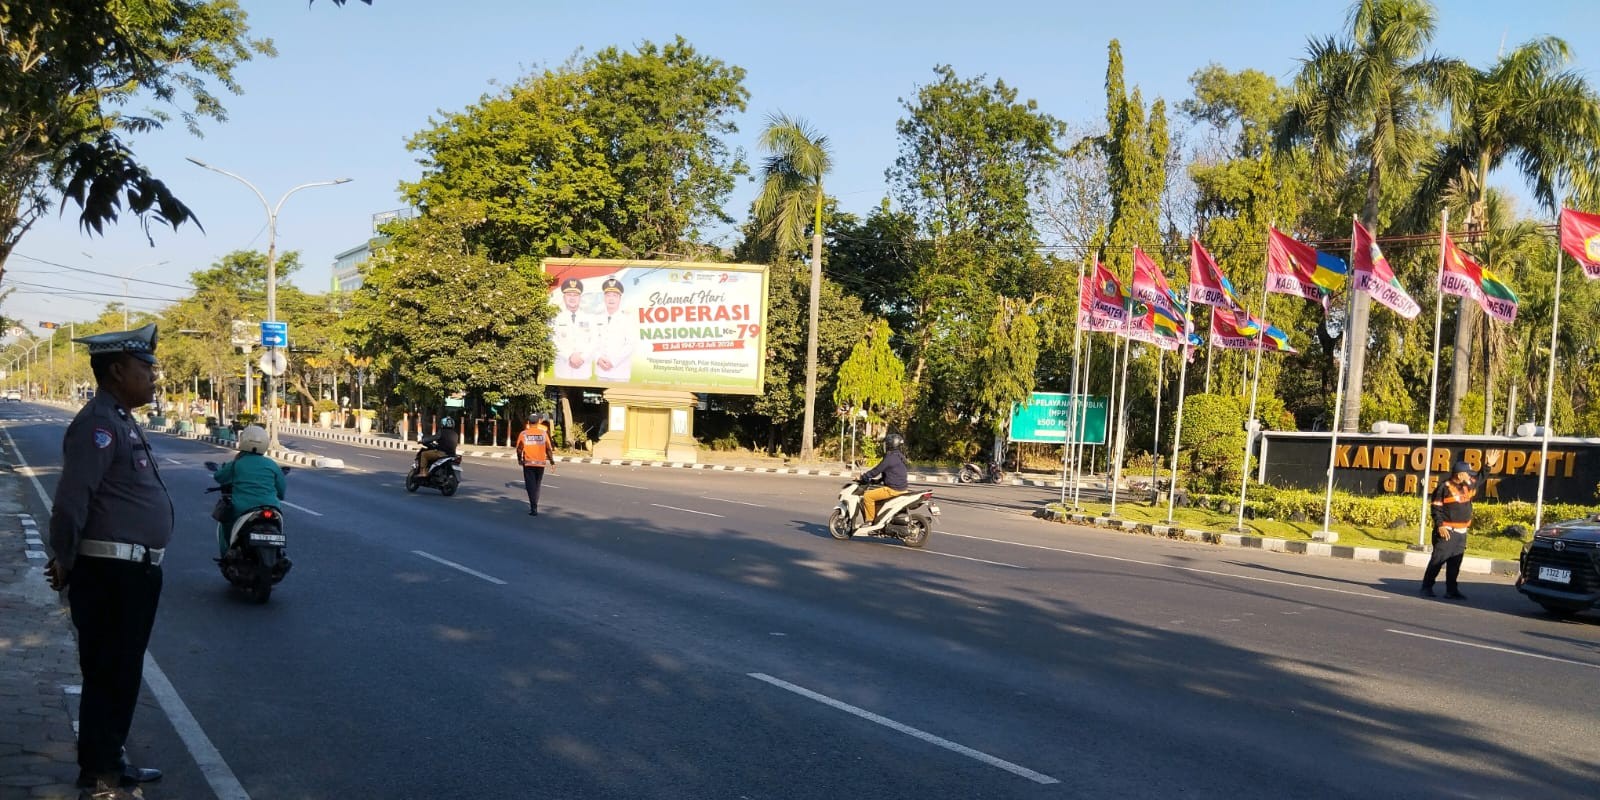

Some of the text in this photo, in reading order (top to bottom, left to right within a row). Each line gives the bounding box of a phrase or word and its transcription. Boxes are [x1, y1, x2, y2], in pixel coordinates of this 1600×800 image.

[649, 289, 726, 307] Selamat Hari
[1382, 288, 1414, 315] GRESIK
[638, 304, 750, 323] KOPERASI
[640, 327, 723, 340] NASIONAL
[1334, 444, 1451, 473] KANTOR
[1384, 474, 1501, 498] GREK
